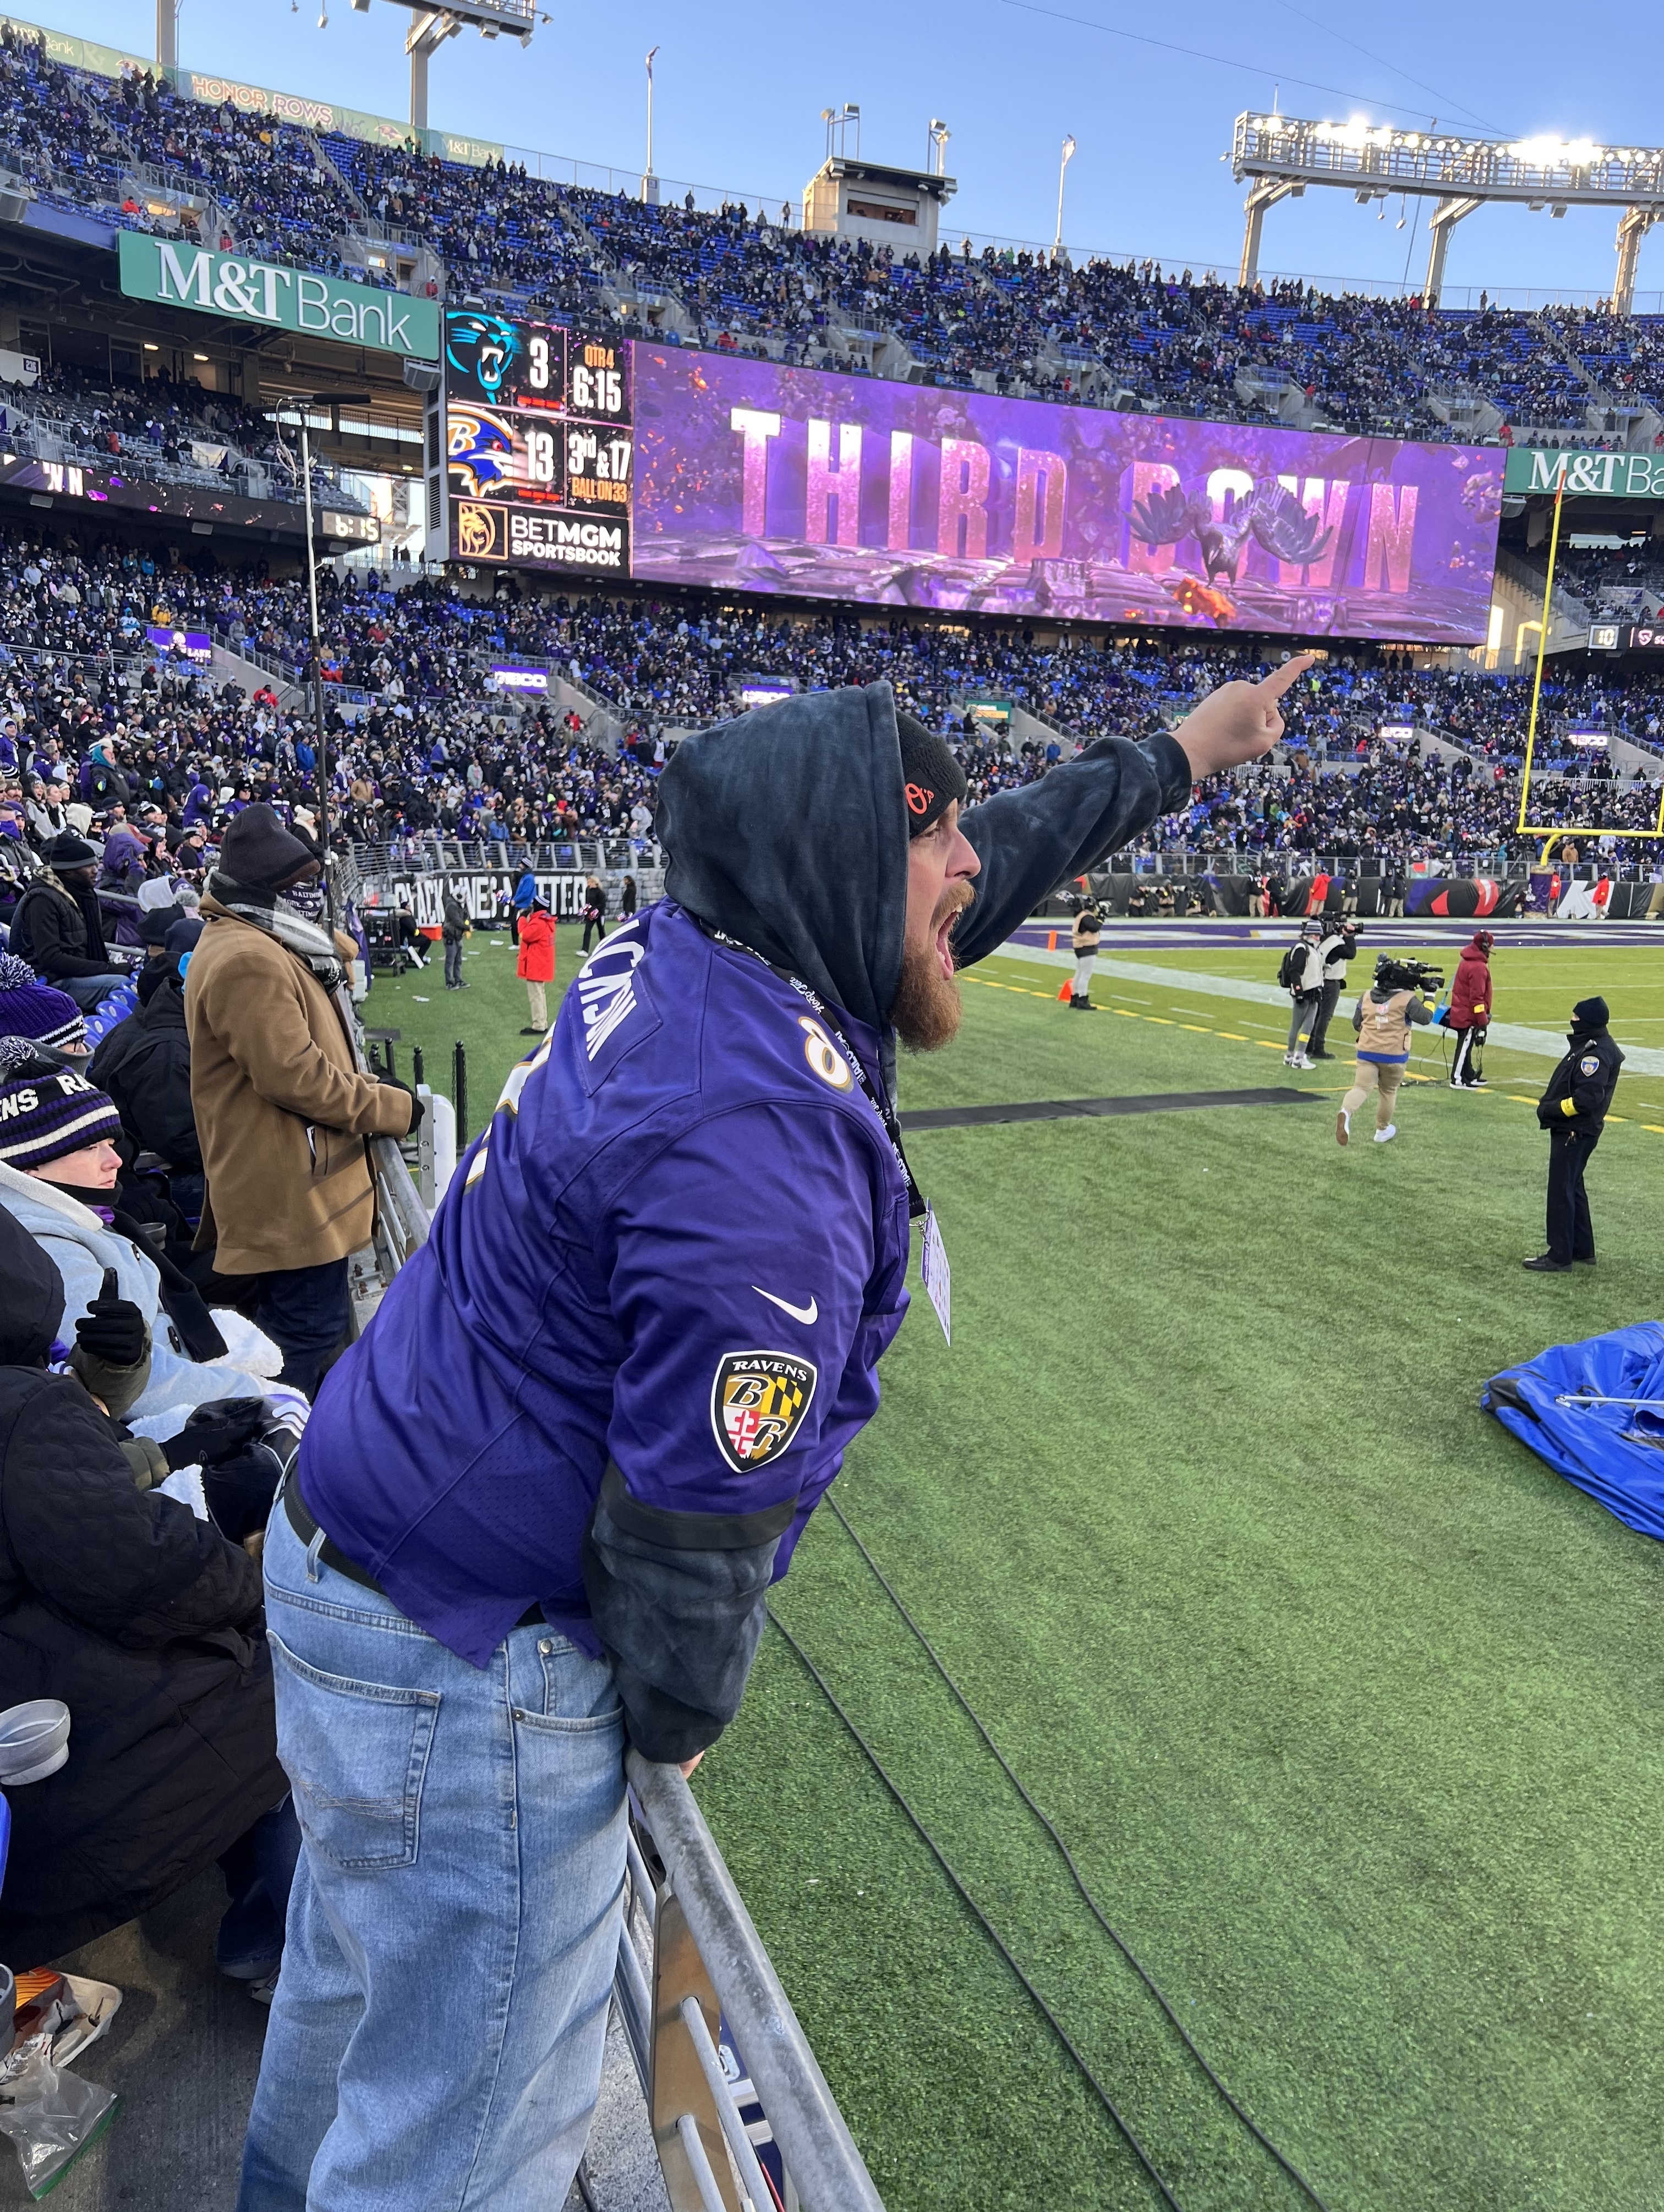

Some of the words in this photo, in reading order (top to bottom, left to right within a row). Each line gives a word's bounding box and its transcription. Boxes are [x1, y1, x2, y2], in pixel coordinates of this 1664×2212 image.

[191, 75, 268, 110] HONOR
[273, 94, 333, 125] ROWS
[441, 137, 471, 156] M&T
[472, 144, 499, 160] Bank
[155, 241, 291, 322] M&T
[297, 275, 413, 350] Bank
[529, 338, 549, 389] 3
[584, 345, 606, 367] QTR
[606, 350, 615, 370] 4
[572, 366, 622, 413] 6:15
[524, 431, 554, 482] 13
[1528, 451, 1625, 493] M&T
[571, 477, 596, 500] BALL
[597, 482, 612, 501] ON
[731, 408, 1067, 563] THIRD
[1125, 460, 1420, 594] DOWN
[336, 515, 379, 540] 6:15
[511, 514, 622, 550] BETMGM
[511, 541, 621, 567] SPORTSBOOK
[1599, 629, 1615, 646] 10
[798, 1016, 853, 1094] 8
[732, 1359, 807, 1382] RAVENS
